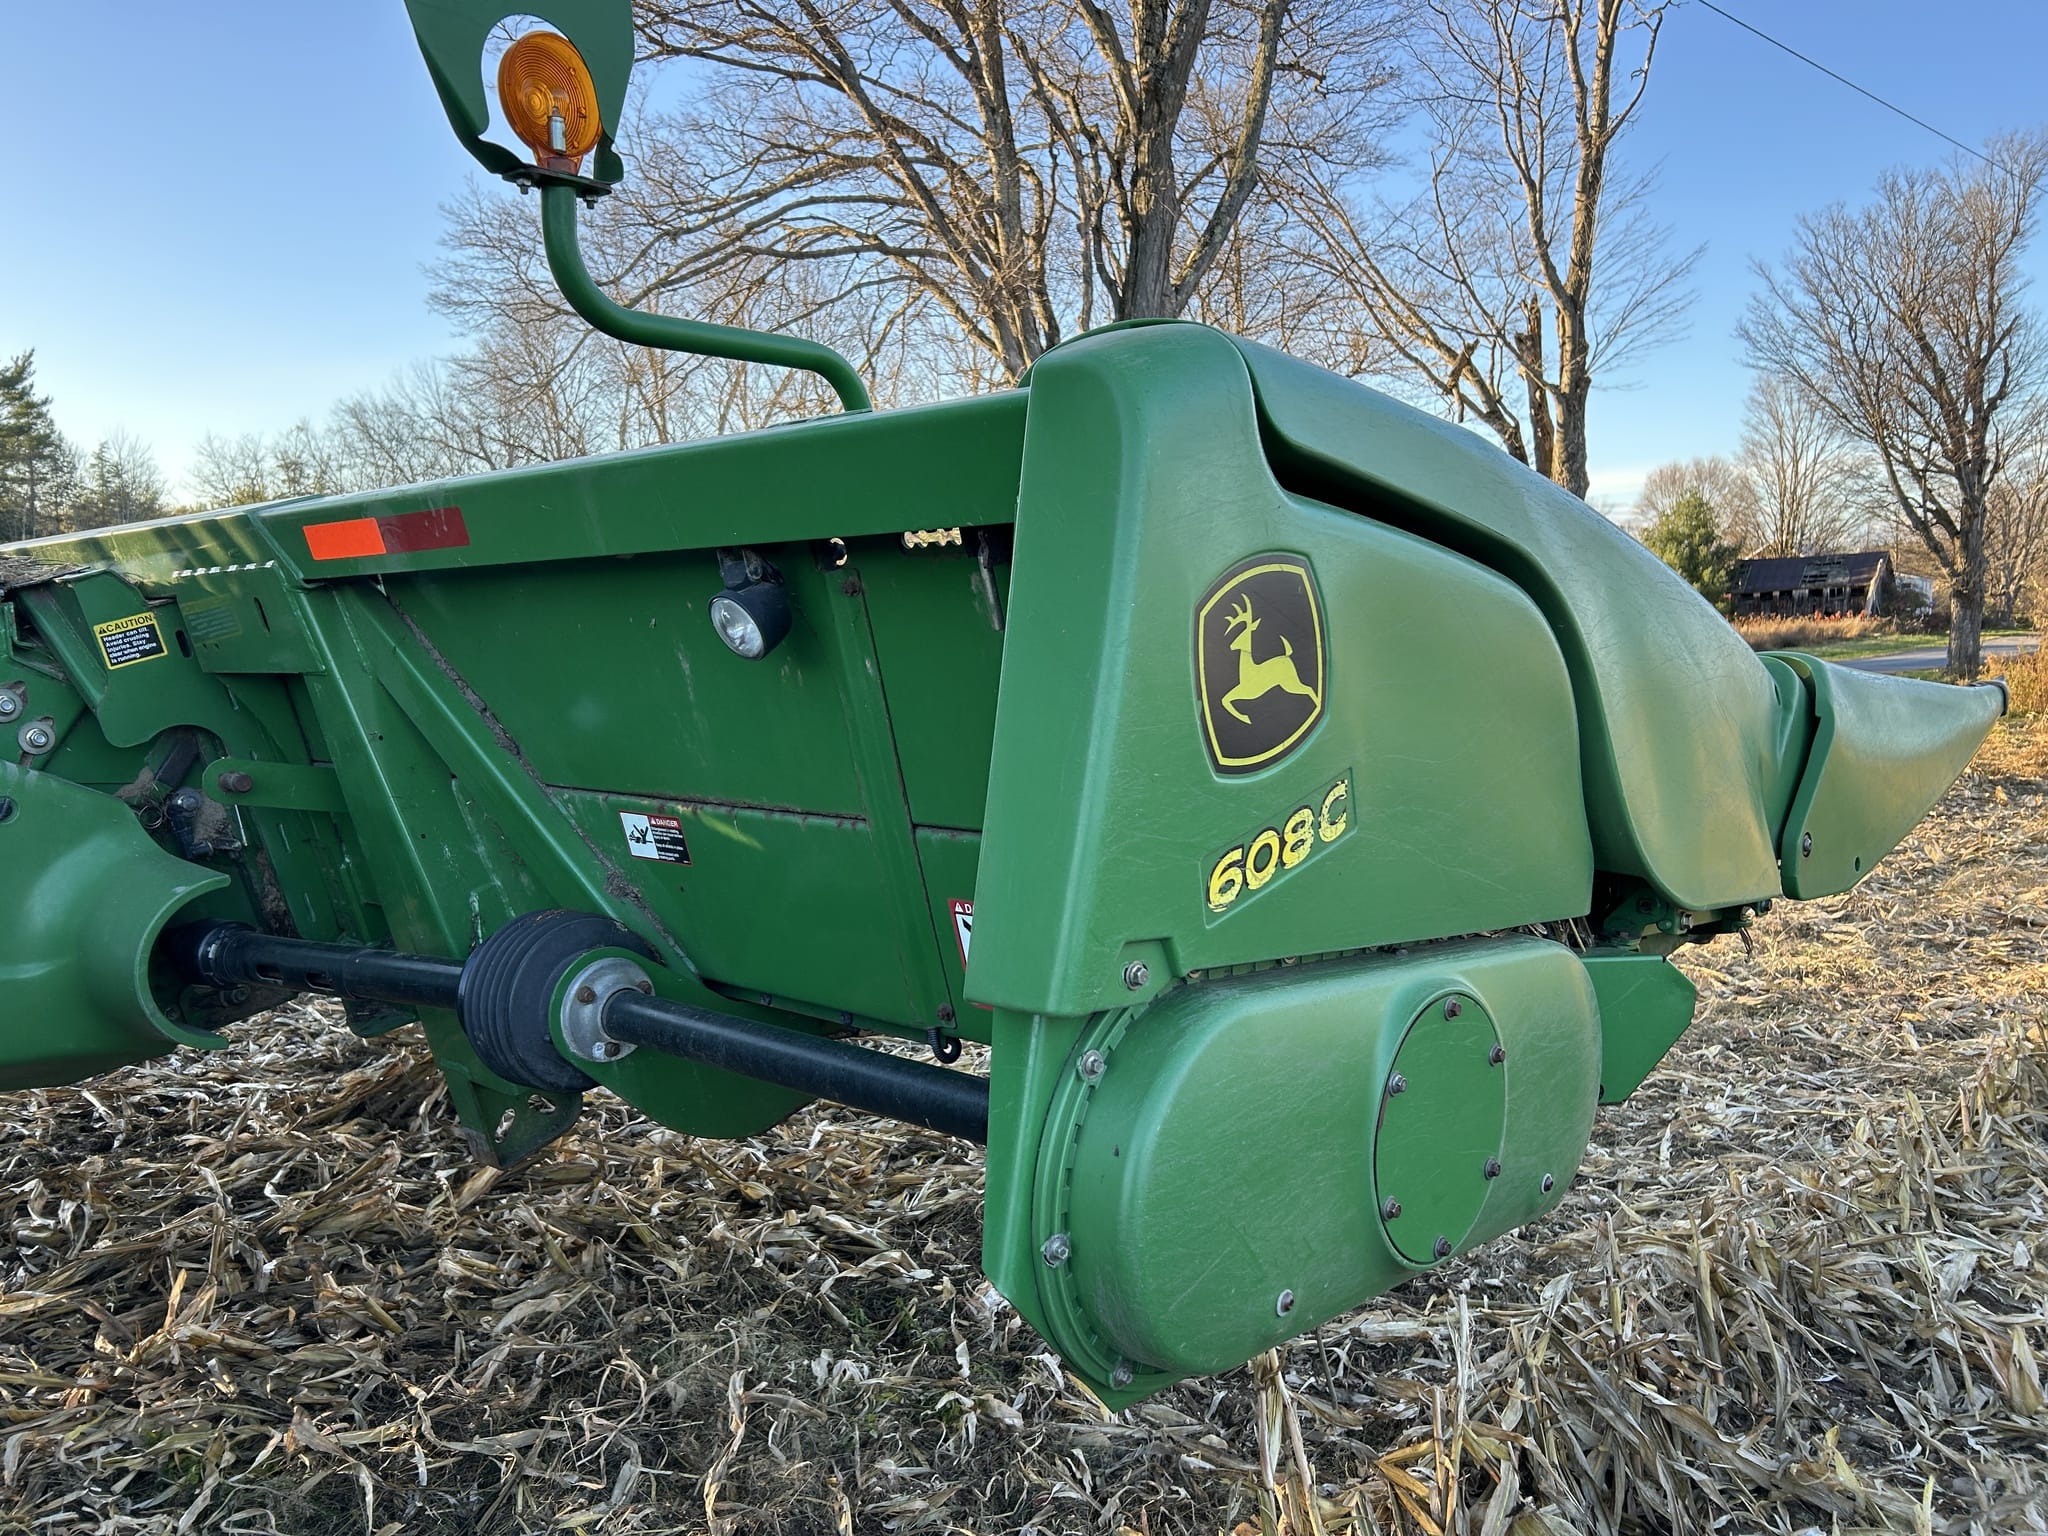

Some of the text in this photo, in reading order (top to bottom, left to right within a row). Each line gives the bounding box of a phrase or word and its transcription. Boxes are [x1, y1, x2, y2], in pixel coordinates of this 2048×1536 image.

[106, 614, 153, 633] CAUTION
[103, 633, 125, 642] Header
[105, 632, 150, 648] Avoid crushing
[132, 638, 146, 647] Stay
[123, 647, 139, 655] when
[138, 642, 157, 650] engine
[655, 818, 679, 828] DANGER
[1207, 779, 1348, 912] 608C
